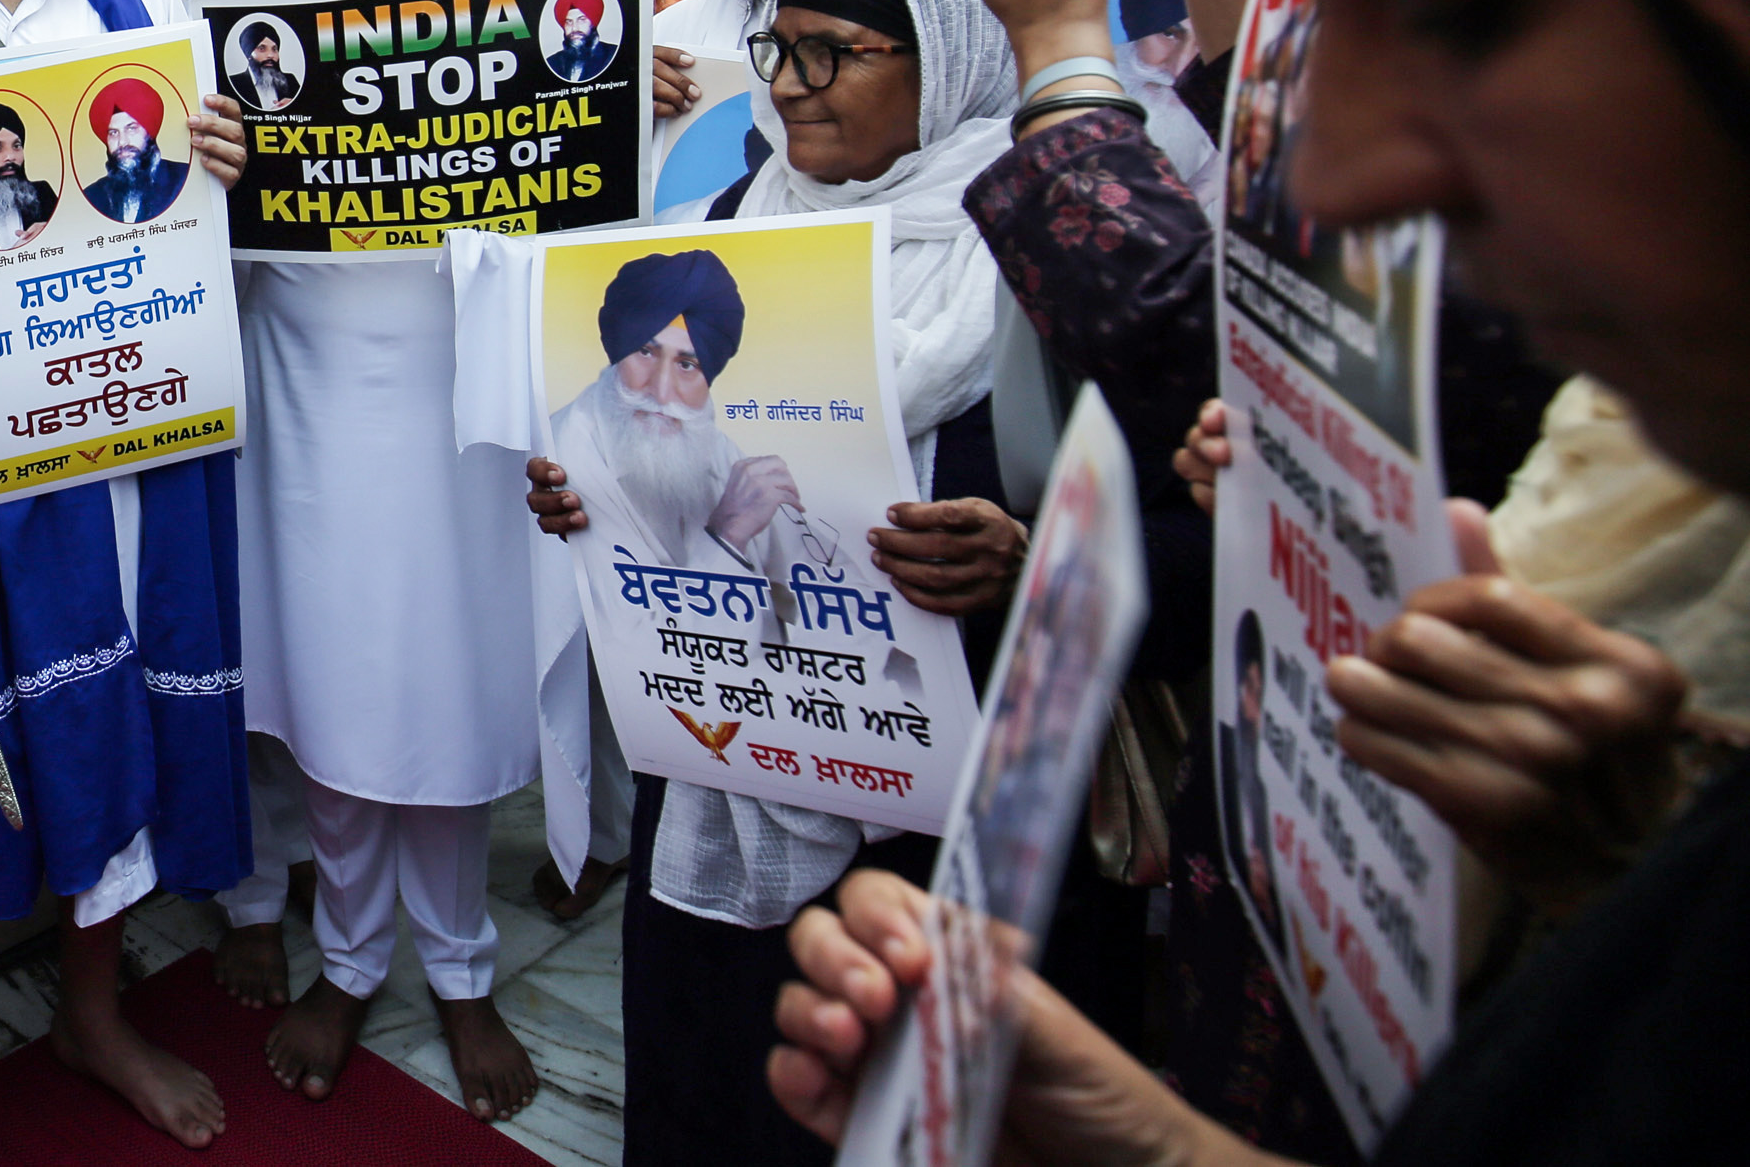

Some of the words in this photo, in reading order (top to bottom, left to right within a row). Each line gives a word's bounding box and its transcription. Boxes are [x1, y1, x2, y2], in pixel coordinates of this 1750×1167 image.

[342, 50, 517, 115] STOP
[535, 88, 569, 100] Paramjit
[571, 85, 593, 96] Singh
[595, 80, 628, 92] Panjwar
[257, 97, 601, 154] EXTRA-JUDICIAL
[302, 146, 496, 184] KILLINGS
[510, 136, 561, 167] OF
[260, 163, 602, 223] KHALISTANIS
[385, 229, 429, 247] DAL
[17, 246, 146, 310] ਸ਼ਹਾਦਤਾਂ
[26, 282, 206, 353] ਲਿਆਉਣਗੀਆਂ
[45, 341, 143, 386] ਕਾਤਲ
[8, 368, 188, 440] ਪਛਤਾਉਣਗੇ
[725, 400, 759, 422] ਭਾਈ
[766, 400, 823, 423] ਗਜਿੰਦਰ
[830, 400, 864, 423] ਸਿੰਘ
[114, 439, 148, 456] DAL
[153, 420, 225, 449] KHALSA
[613, 544, 768, 623] ਬੇਵਤਨਾ
[791, 562, 894, 641] ਸਿੱਖ
[640, 668, 704, 708] ਮਦਦ
[719, 676, 774, 719] ਲਈ
[788, 683, 847, 732] ਅੱਗੇ
[860, 700, 933, 748] ਆਵੇ
[747, 741, 800, 775] ਦਲ
[812, 751, 913, 798] ਖ਼ਾਲਸਾ
